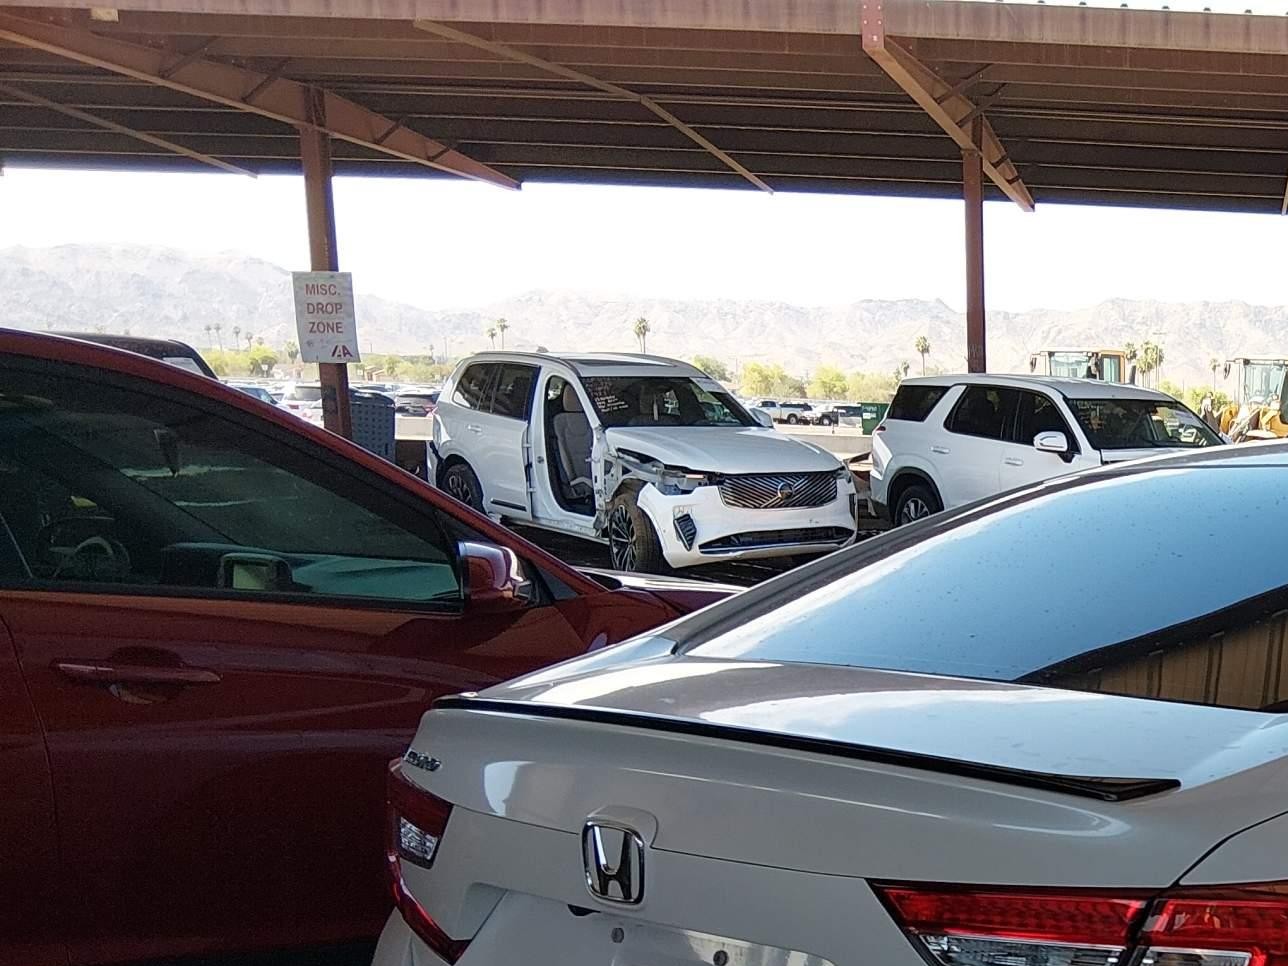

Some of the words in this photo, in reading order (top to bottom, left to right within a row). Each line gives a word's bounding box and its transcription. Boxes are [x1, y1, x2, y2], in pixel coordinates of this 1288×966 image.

[305, 283, 341, 296] MISC.
[306, 302, 343, 315] DROP
[308, 322, 344, 334] ZONE
